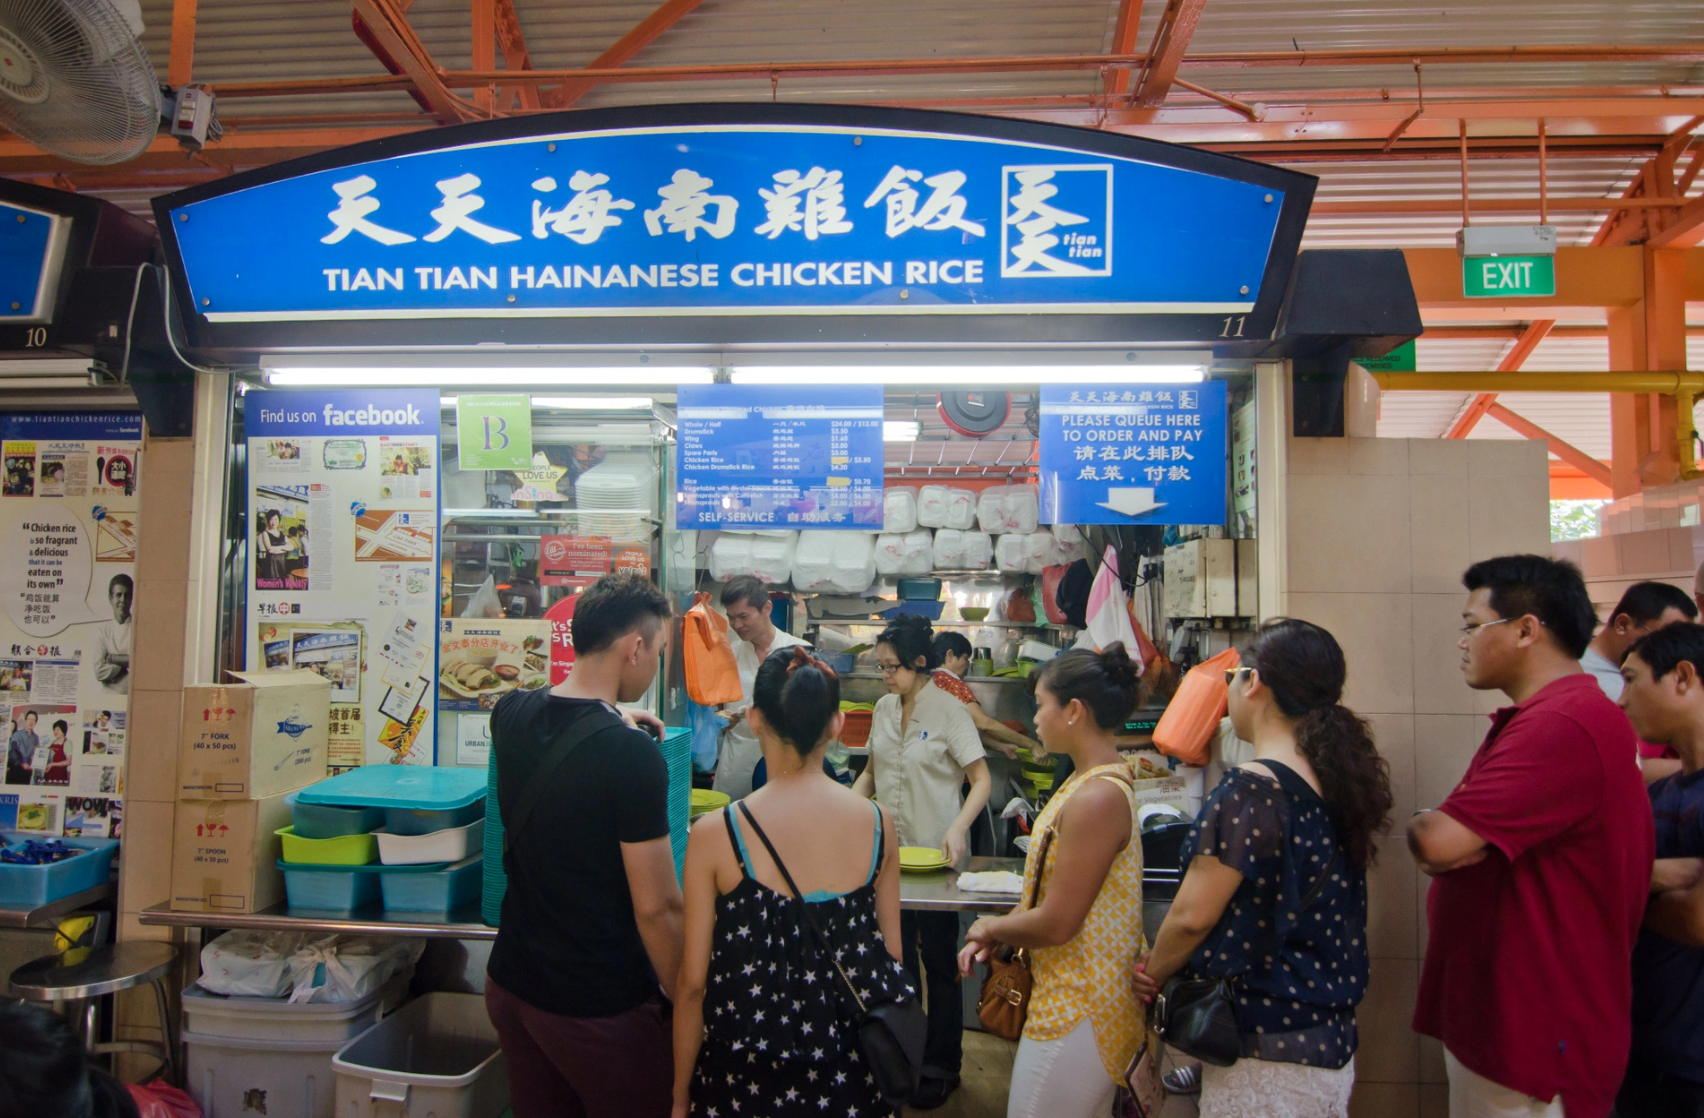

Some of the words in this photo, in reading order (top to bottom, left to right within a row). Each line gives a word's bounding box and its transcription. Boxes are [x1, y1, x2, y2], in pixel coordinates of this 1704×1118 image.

[1062, 233, 1096, 245] tian
[1068, 245, 1102, 258] tian
[323, 268, 404, 292] TIAN
[415, 266, 498, 291] TIAN
[510, 264, 719, 290] HAINANESE
[731, 262, 893, 287] CHICKEN
[905, 259, 984, 285] RICE
[1483, 262, 1534, 289] EXIT
[1219, 317, 1244, 337] 11
[25, 327, 47, 348] 10
[260, 409, 284, 423] Find
[287, 412, 300, 423] us
[302, 412, 317, 423] on
[323, 404, 421, 426] facebook
[1062, 414, 1111, 426] PLEASE
[1115, 414, 1162, 427] QUEUE
[1166, 414, 1201, 426] HERE
[481, 416, 510, 451] B
[1063, 430, 1082, 442] TO
[1086, 430, 1134, 442] ORDER
[1138, 430, 1170, 442] AND
[1174, 430, 1204, 442] PAY
[1073, 445, 1195, 461] 请在此排队
[522, 472, 545, 480] LOVE
[546, 472, 558, 480] US
[698, 512, 775, 522] SELF-SERVICE
[787, 512, 847, 522] 自助服务
[62, 523, 76, 532] rice
[45, 536, 78, 546] fragrant
[34, 546, 68, 556] delicious
[28, 568, 50, 576] eaten
[52, 568, 62, 576] on
[27, 579, 37, 589] its
[257, 578, 283, 590] Women's
[285, 579, 308, 590] Weekly
[24, 604, 50, 614] 净吃饭
[1144, 794, 1182, 804] Vegetables
